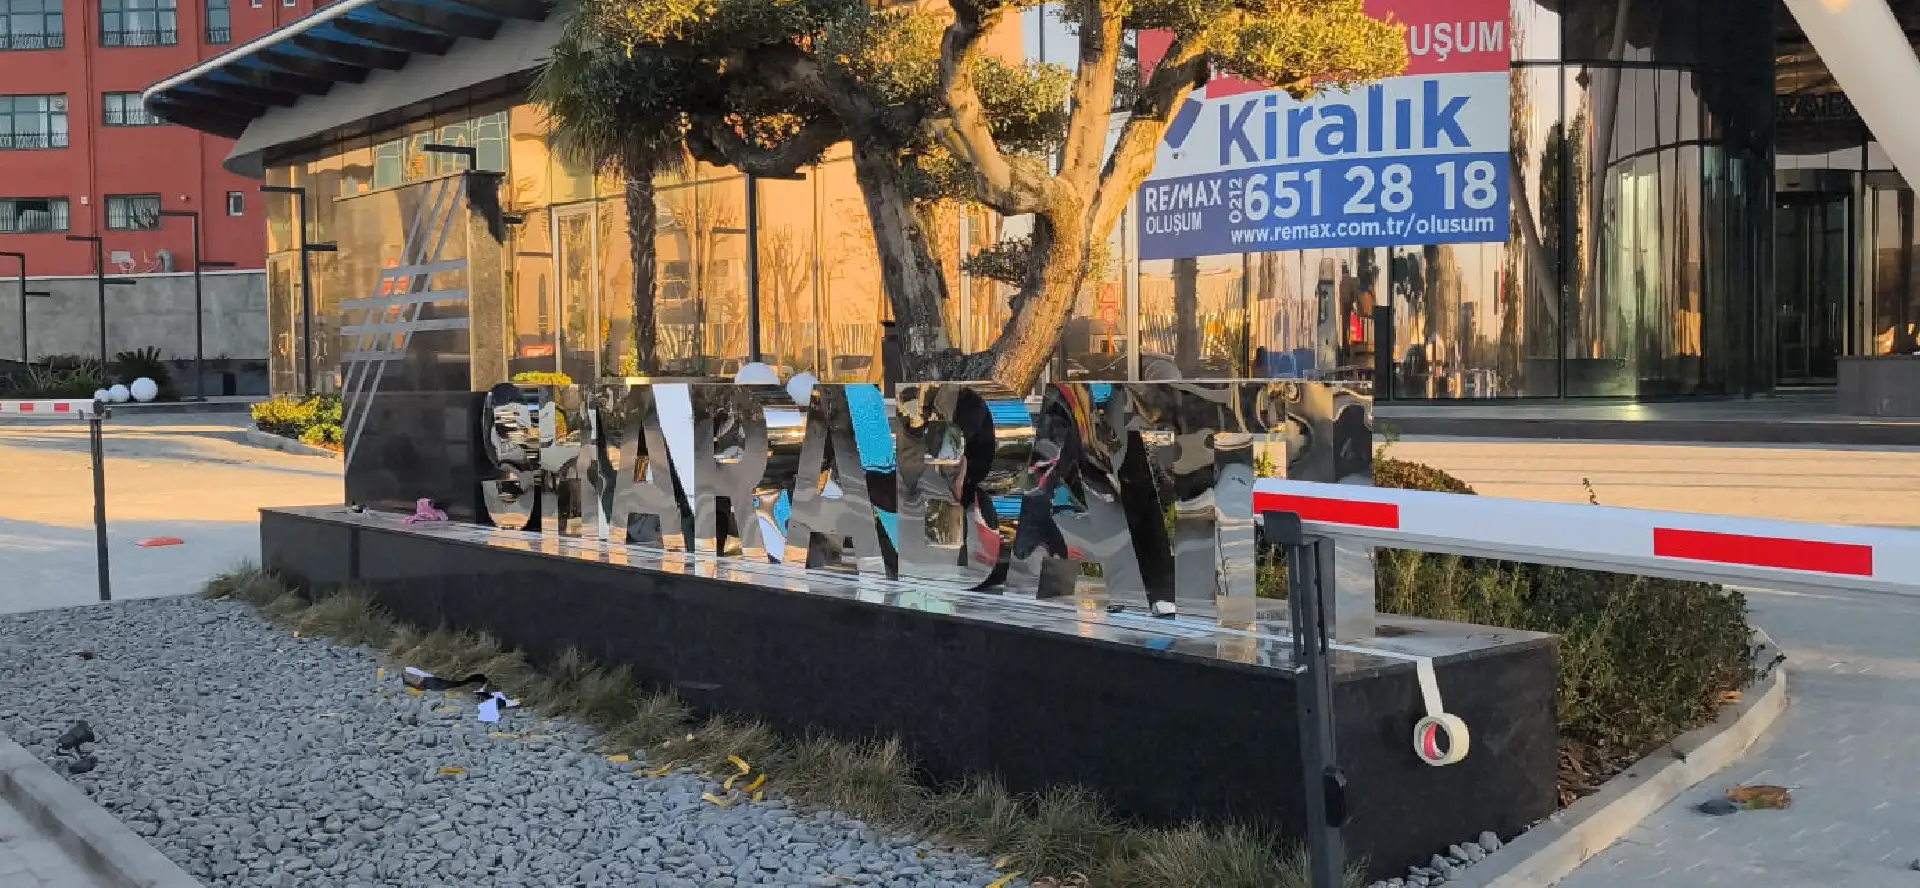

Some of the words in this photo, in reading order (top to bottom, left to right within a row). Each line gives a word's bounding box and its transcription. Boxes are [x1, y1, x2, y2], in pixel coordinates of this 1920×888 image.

[1410, 21, 1504, 62] UŞUM
[1219, 80, 1472, 166] Kiralık
[1145, 179, 1222, 213] RE/MAX
[1228, 177, 1243, 224] 0212
[1244, 170, 1322, 221] 651
[1343, 164, 1413, 214] 28
[1435, 161, 1498, 210] 18
[1146, 212, 1202, 236] OLUŞUM
[1231, 213, 1495, 245] www.remax.com.tr/olusum
